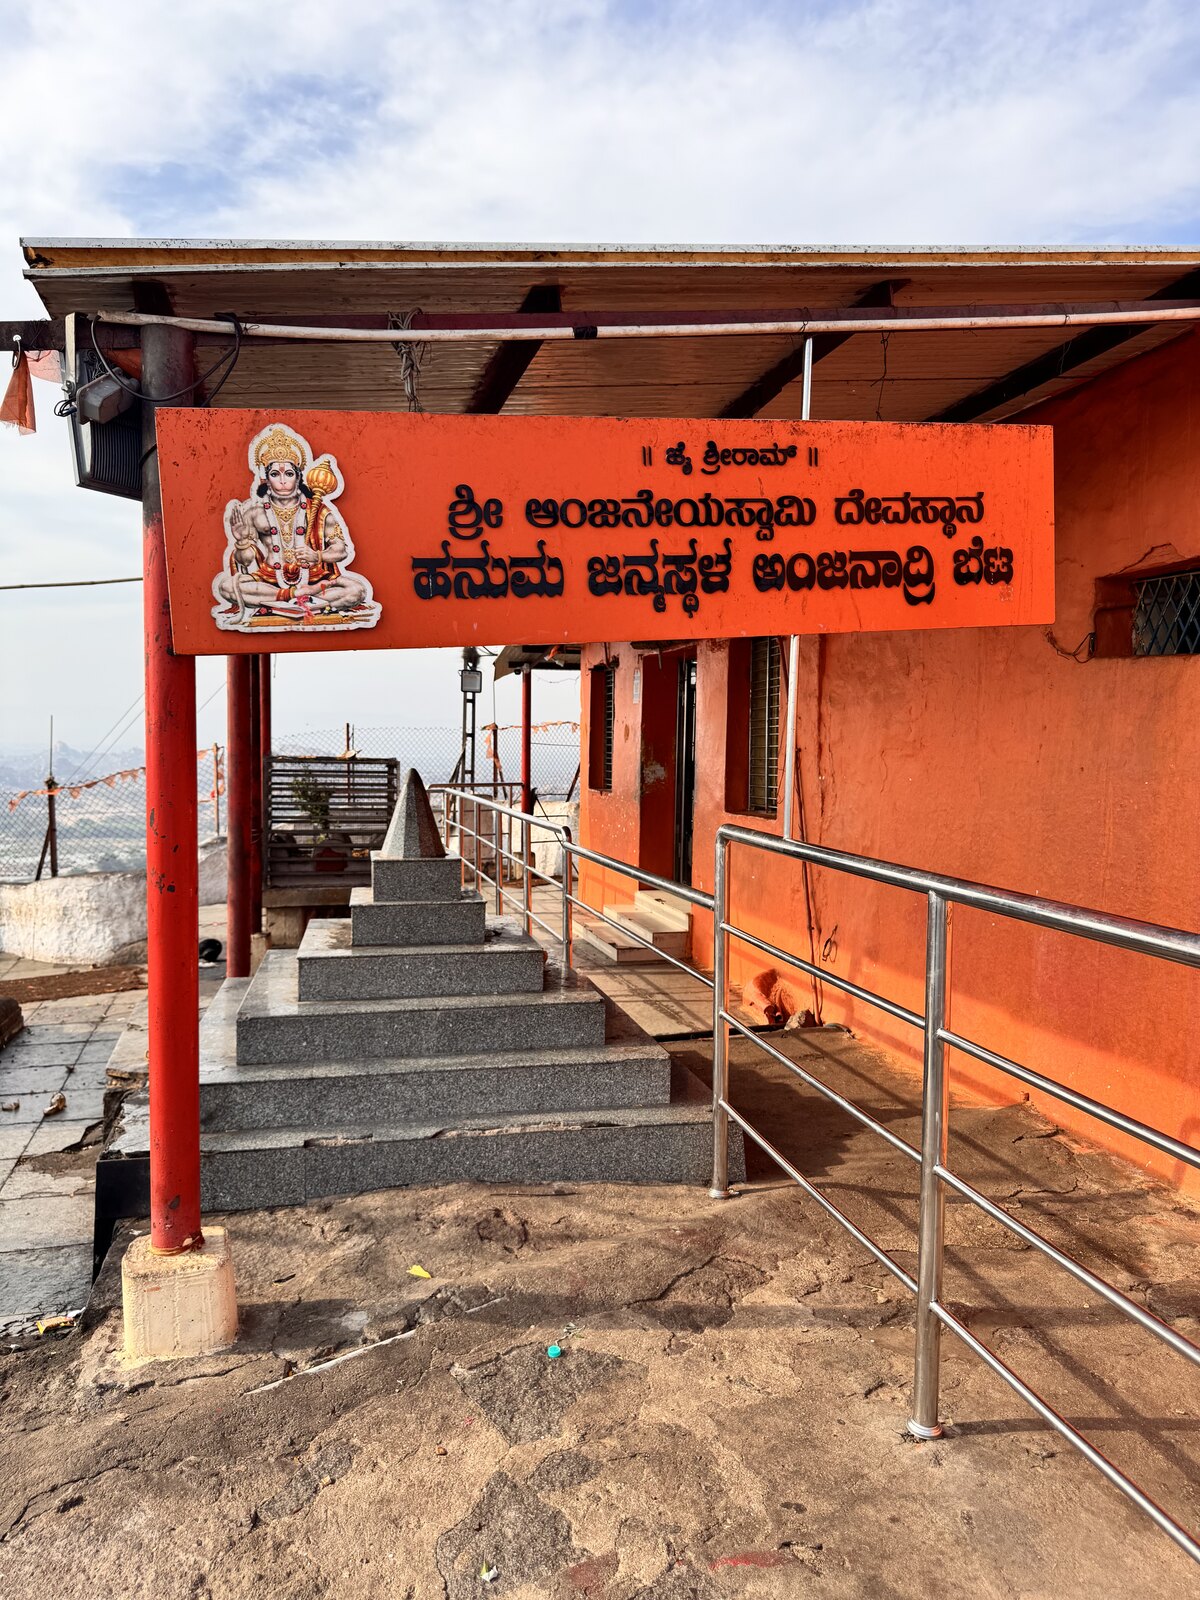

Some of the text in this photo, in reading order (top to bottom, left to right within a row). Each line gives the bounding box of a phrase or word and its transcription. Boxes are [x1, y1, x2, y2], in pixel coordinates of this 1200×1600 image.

[665, 441, 693, 476] ಜೈ
[701, 440, 798, 476] ಶ್ರೀರಾಮ್
[447, 483, 985, 542] ಶ್ರೀ ಆಂಜನೇಯಸ್ವಾಮಿ ದೇವಸ್ಥಾನ
[410, 539, 565, 601] ಹನುಮ
[587, 537, 733, 619] ಜನ್ಮಸ್ಥಳ
[752, 545, 936, 607] ಅಂಜನಾದ್ರಿ
